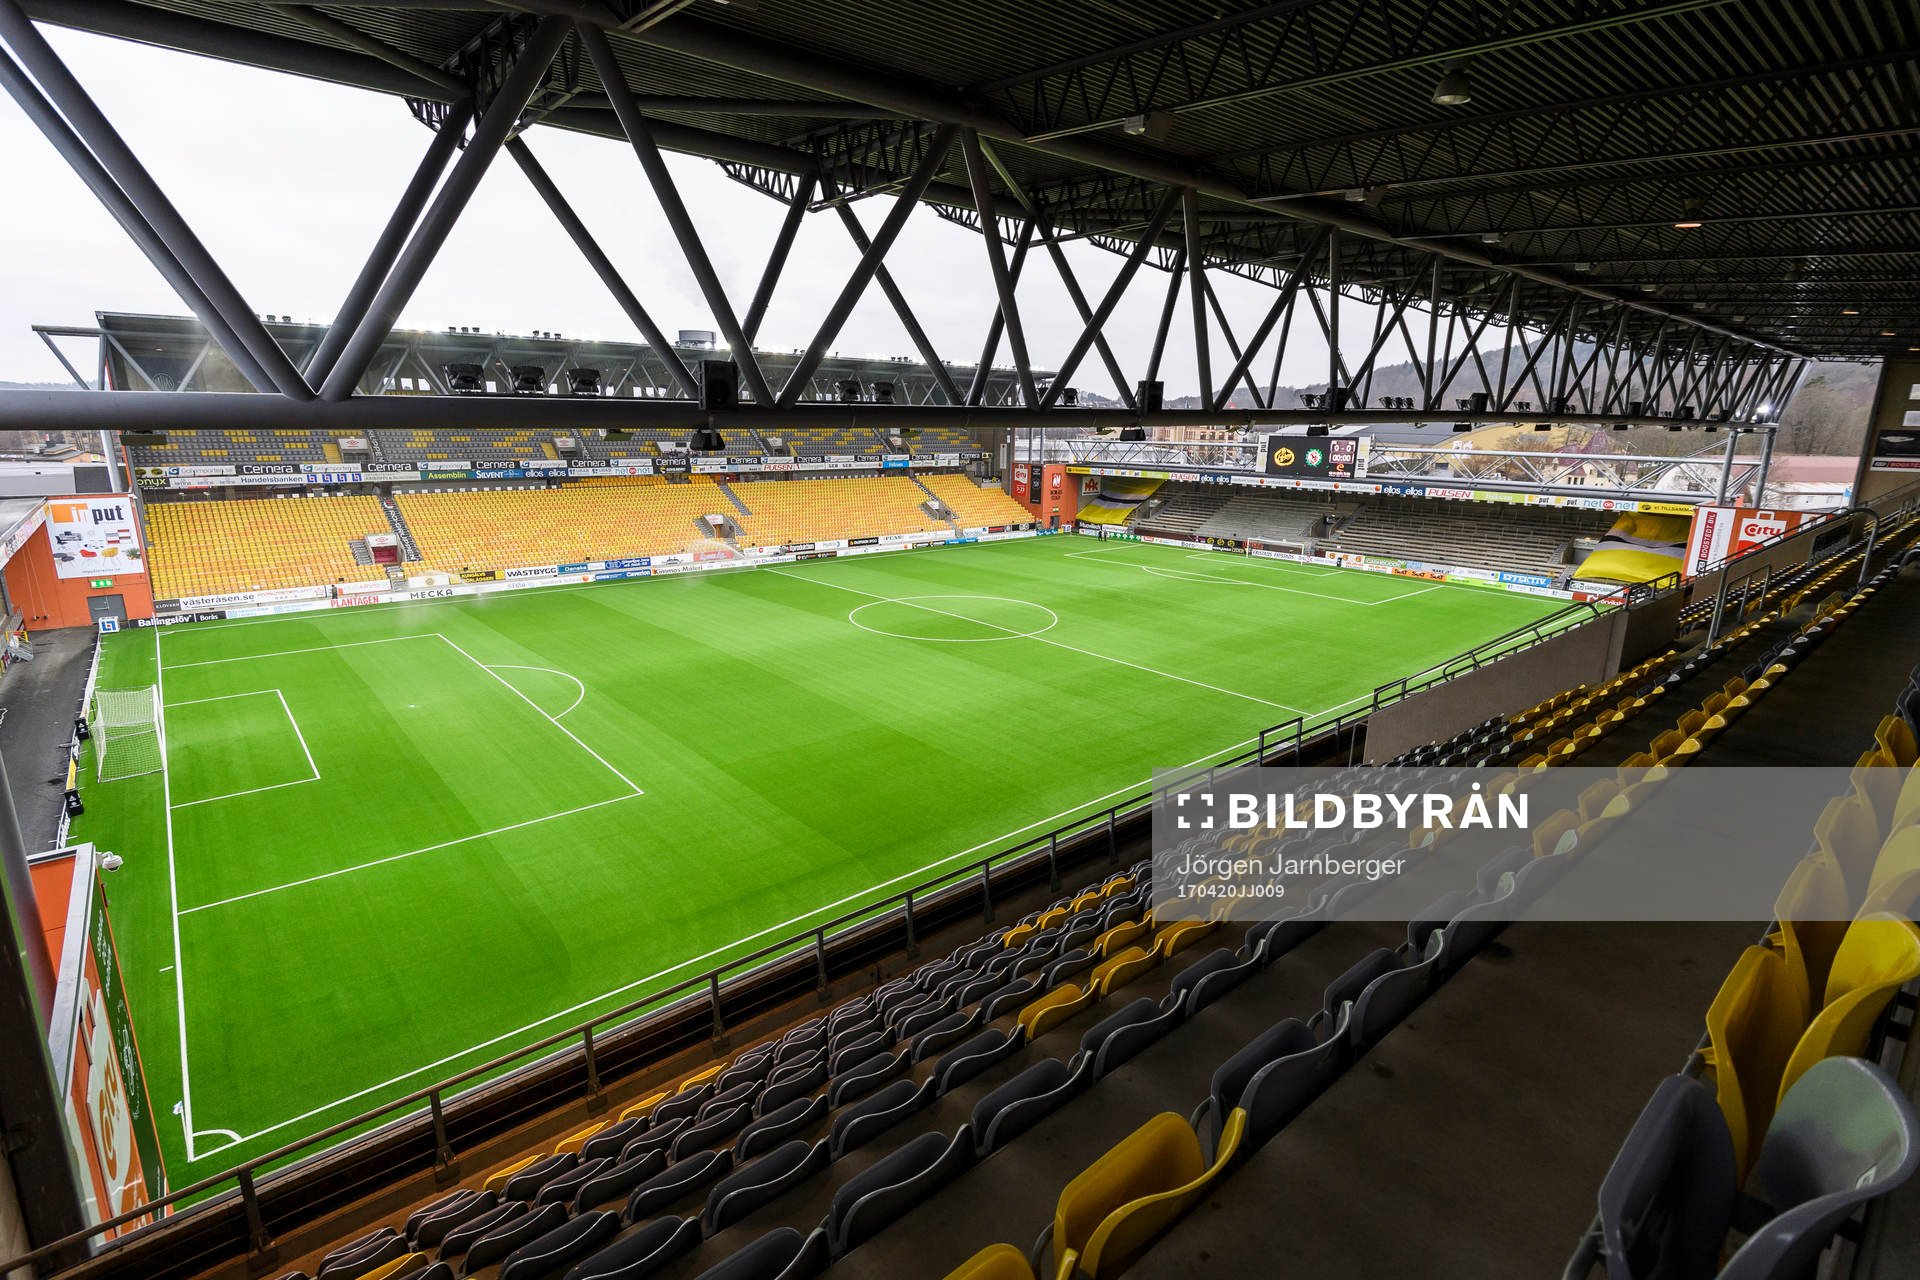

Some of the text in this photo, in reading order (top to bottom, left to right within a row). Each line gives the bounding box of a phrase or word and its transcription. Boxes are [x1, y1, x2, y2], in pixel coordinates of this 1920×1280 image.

[476, 460, 515, 469] Cernera
[571, 459, 606, 468] Cernera
[655, 458, 687, 466] Cernera
[242, 464, 294, 474] Cernera
[367, 463, 412, 472] Cernera
[475, 470, 504, 479] SILVENT
[525, 469, 544, 478] ellos
[548, 468, 567, 477] ellos
[240, 475, 303, 484] Handelsbanken
[1216, 475, 1229, 483] ellos
[1383, 485, 1401, 495] ellos
[1405, 487, 1423, 496] ellos
[1428, 488, 1471, 498] PULSEN
[1744, 523, 1782, 537] City
[506, 567, 557, 578] WÄSTBYGG
[410, 588, 453, 600] MECKA
[182, 594, 255, 607] västeråsen.se
[330, 595, 379, 608] PLANTAGEN
[200, 613, 219, 622] Borås
